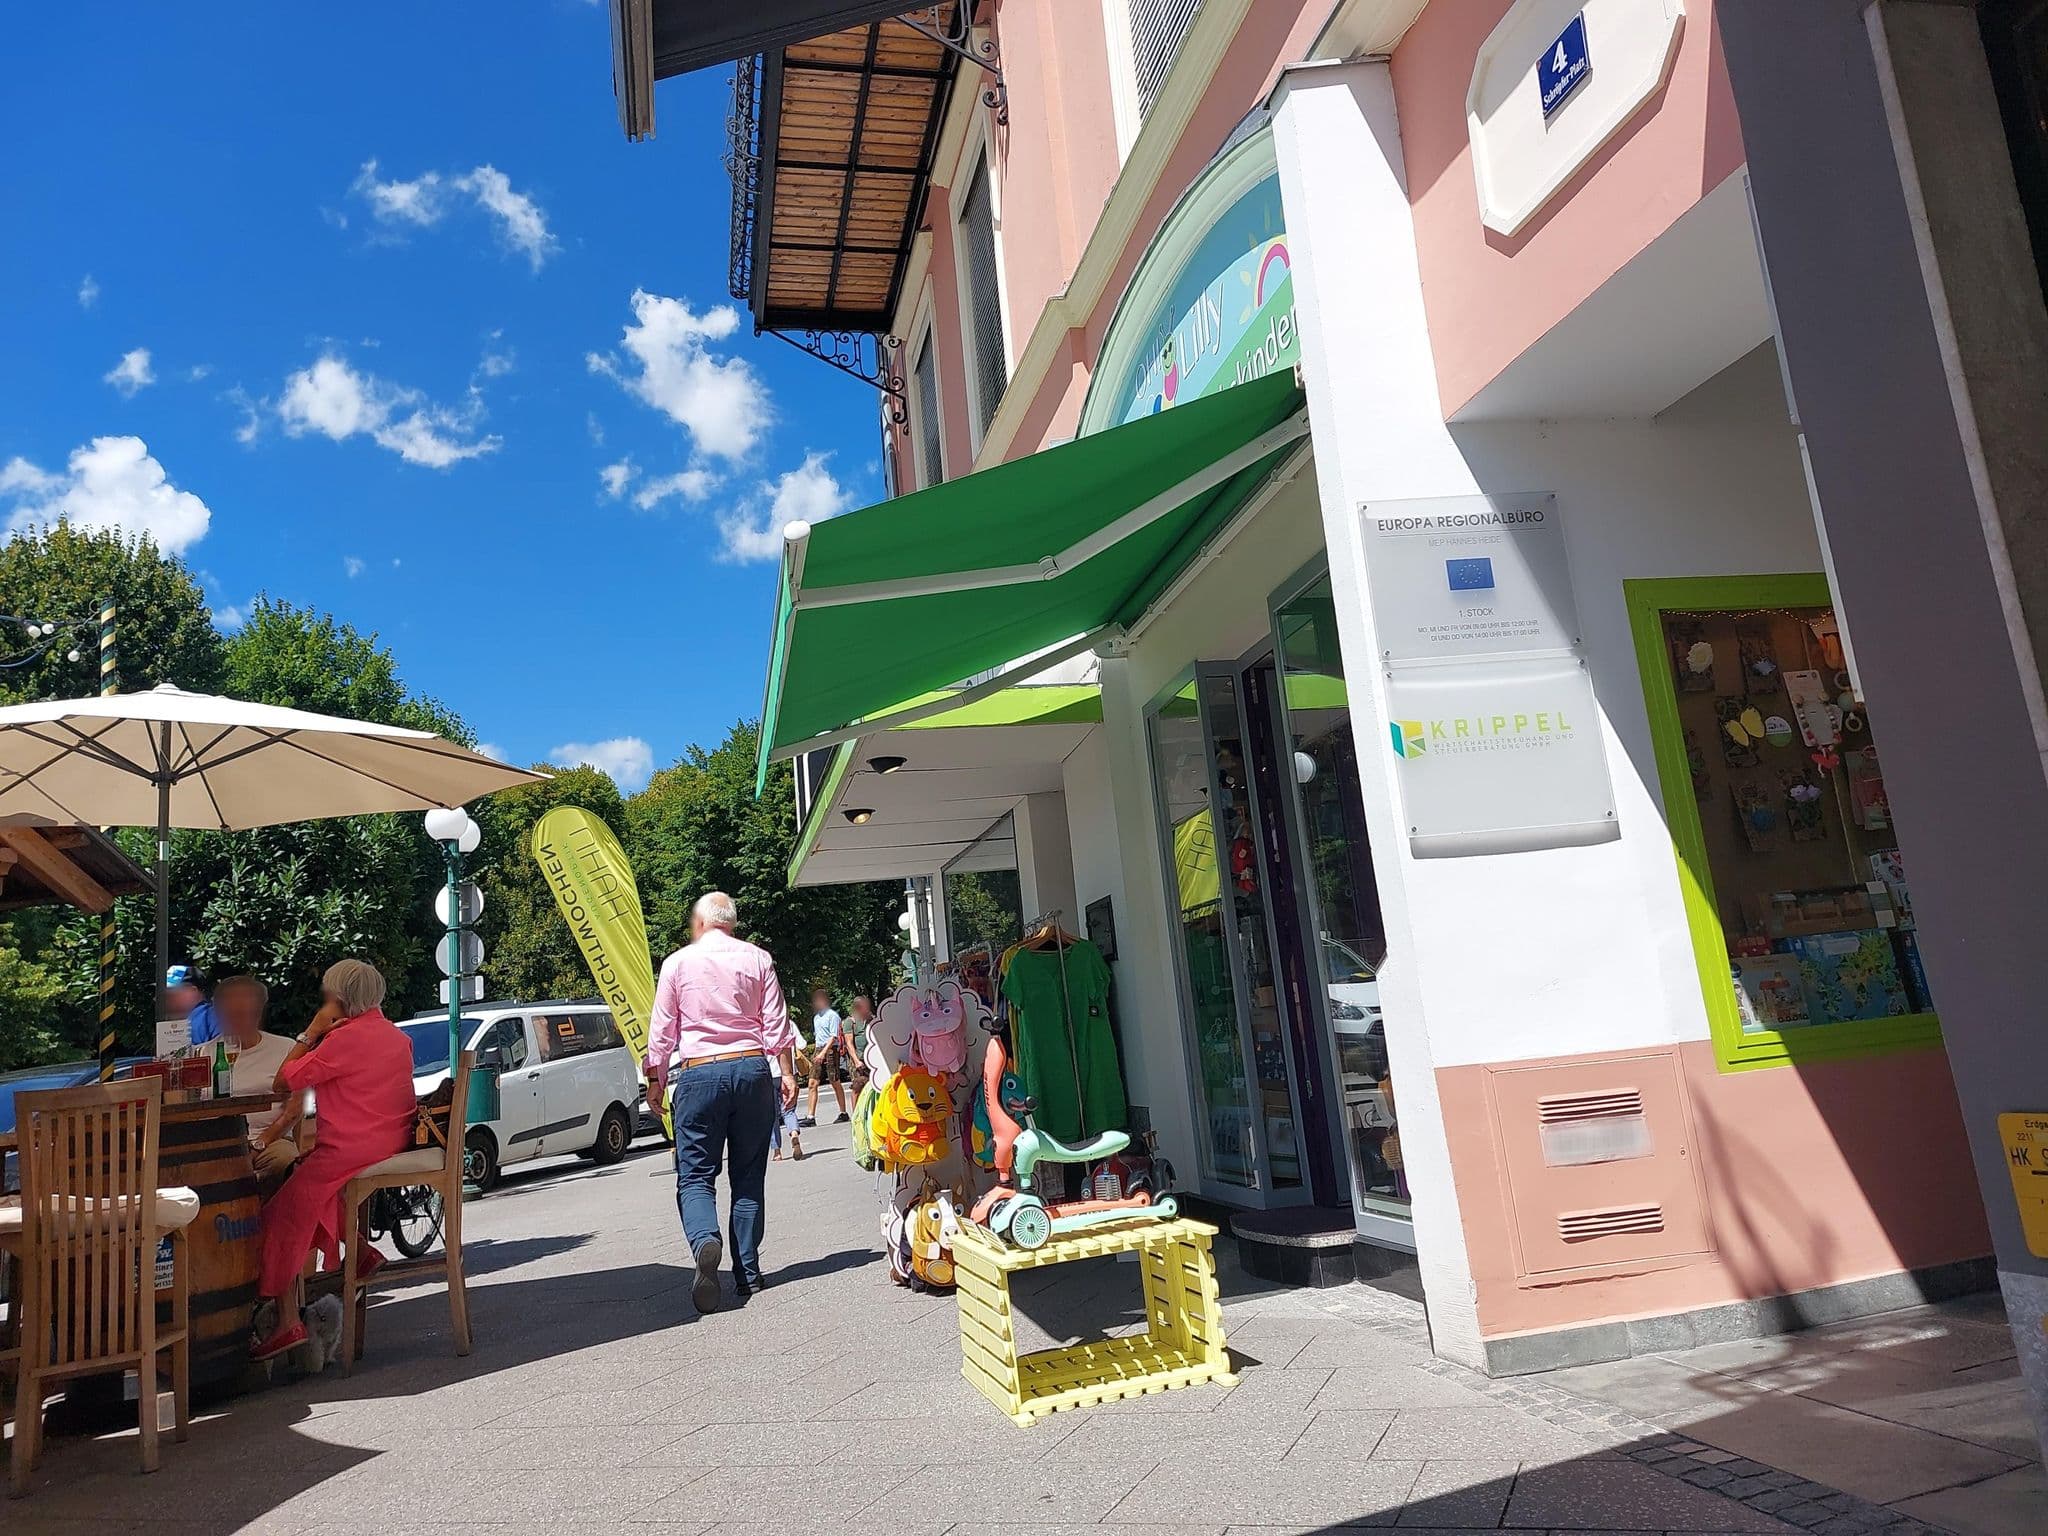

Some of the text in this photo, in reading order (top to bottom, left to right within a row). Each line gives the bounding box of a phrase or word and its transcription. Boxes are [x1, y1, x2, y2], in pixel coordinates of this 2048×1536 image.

[1551, 40, 1568, 74] 4
[1175, 282, 1224, 380] Lilly
[1377, 510, 1545, 532] EUROPA REGIONALBÜRO
[1458, 607, 1495, 619] 1. STOCK
[1430, 711, 1574, 739] KRIPPEL
[2010, 1146, 2033, 1166] HK
